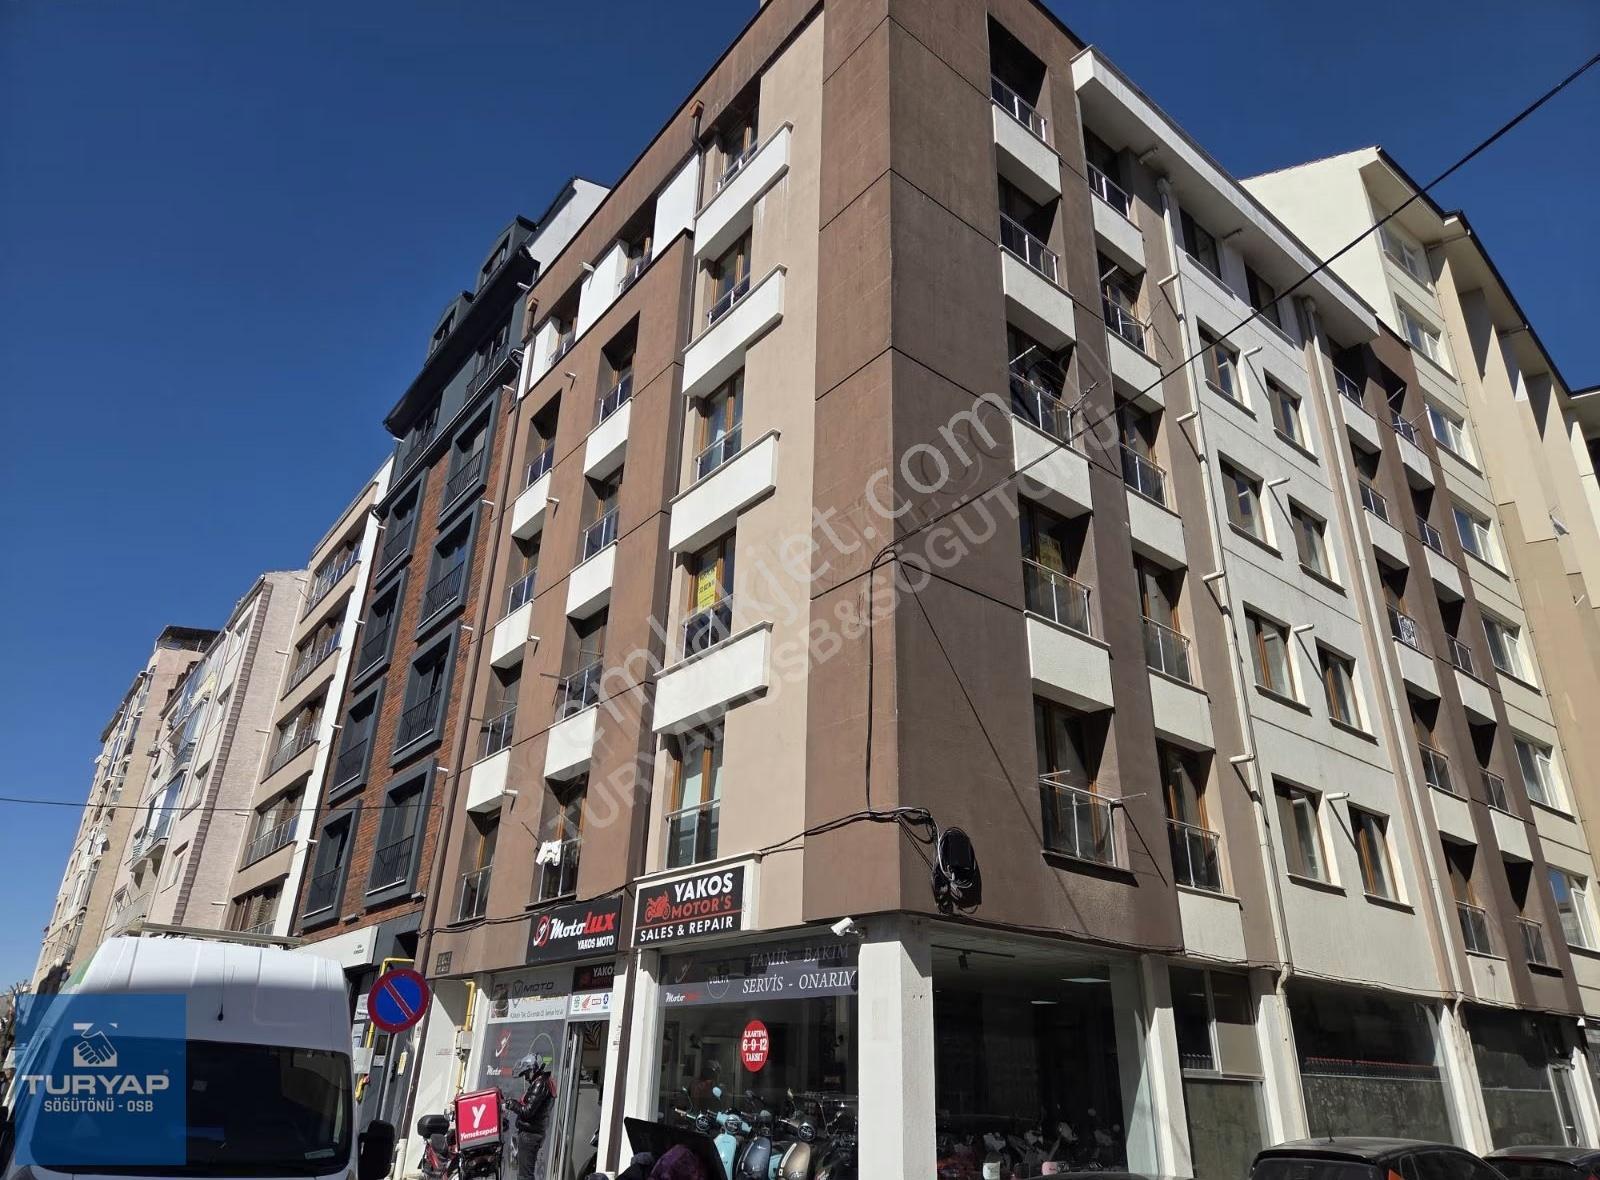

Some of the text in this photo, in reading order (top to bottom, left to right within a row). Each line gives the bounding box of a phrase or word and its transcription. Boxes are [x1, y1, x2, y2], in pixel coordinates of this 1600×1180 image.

[674, 872, 734, 902] YAKOS
[671, 895, 732, 919] MOTOR'S
[640, 916, 734, 942] SALES & REPAIR
[577, 935, 615, 951] YAKOS MOTO
[593, 966, 616, 977] YAKO
[743, 974, 784, 994] SERVİS
[742, 1038, 767, 1052] 6-9-12
